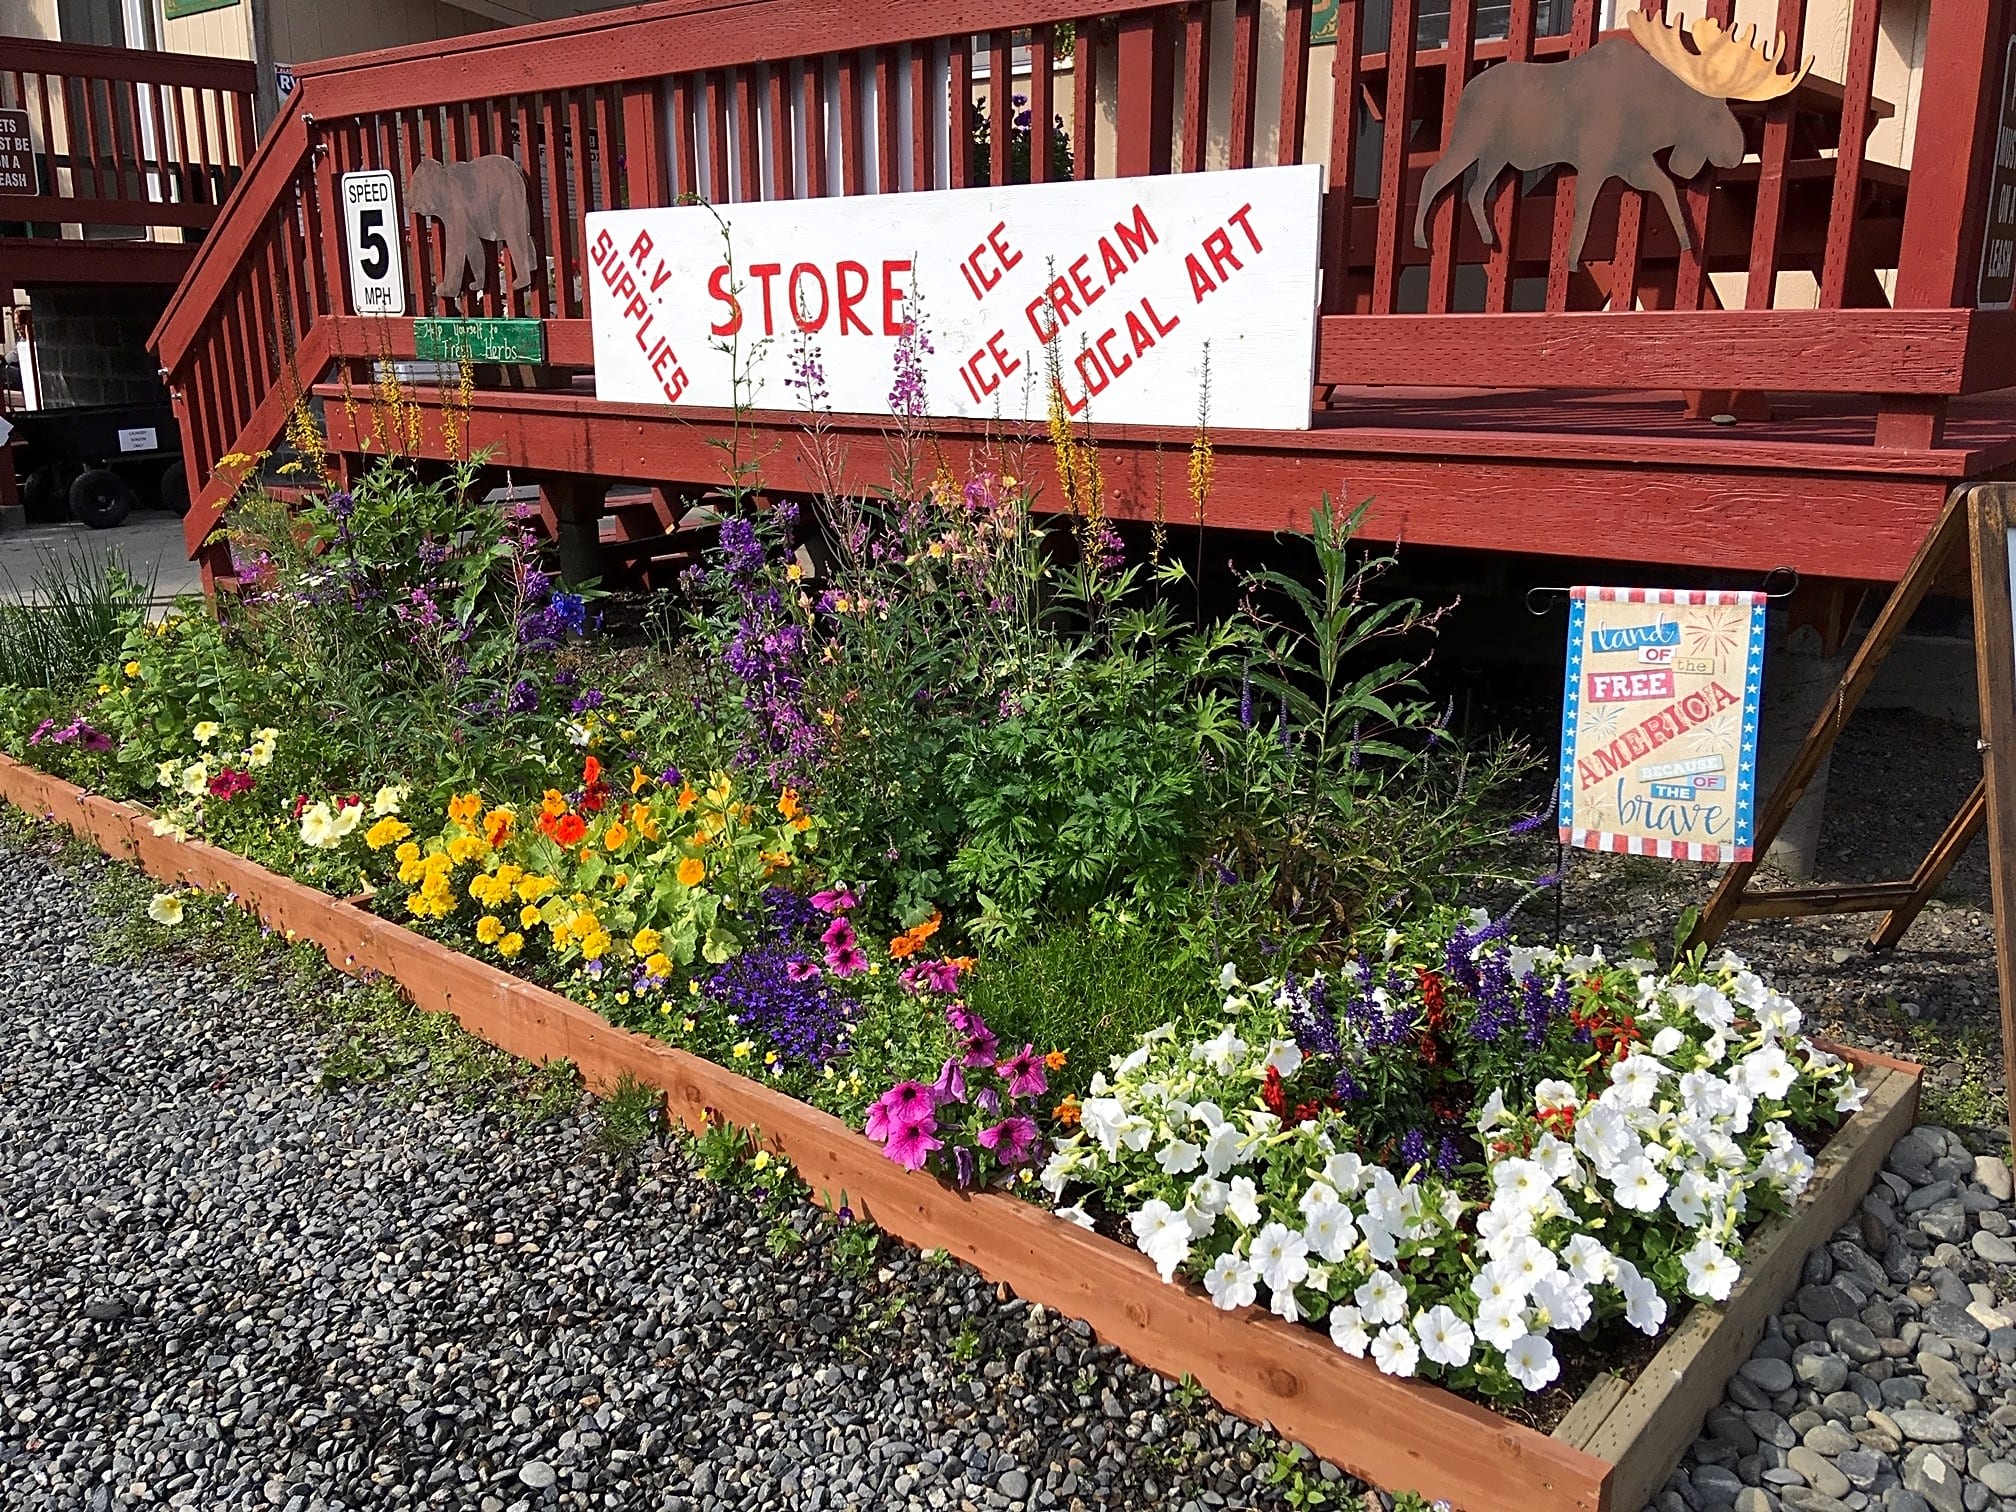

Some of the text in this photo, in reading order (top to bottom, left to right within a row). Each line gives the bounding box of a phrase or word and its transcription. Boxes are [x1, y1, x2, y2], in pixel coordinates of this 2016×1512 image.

[14, 137, 30, 151] BE
[12, 155, 21, 169] A
[349, 183, 388, 203] SPEED
[360, 209, 389, 280] 5
[629, 228, 672, 304] R.V.
[960, 221, 1023, 301] ICE
[1988, 239, 2014, 278] LEASH
[365, 287, 392, 305] MPH
[708, 260, 912, 336] STORE
[959, 203, 1159, 404] ICE CREAM
[1052, 202, 1263, 416] LOCAL ART
[590, 228, 690, 403] SUPPLIES
[489, 323, 498, 339] to
[442, 337, 517, 359] Fresh Herbs
[1599, 611, 1674, 650] land
[1646, 648, 1671, 661] OF
[1677, 659, 1707, 672] the
[1593, 673, 1668, 699] FREE
[1575, 681, 1740, 791] AMERICA
[1640, 757, 1719, 779] BECAUSE
[1655, 785, 1690, 799] THE
[1693, 776, 1719, 788] OF
[1617, 777, 1730, 836] brave
